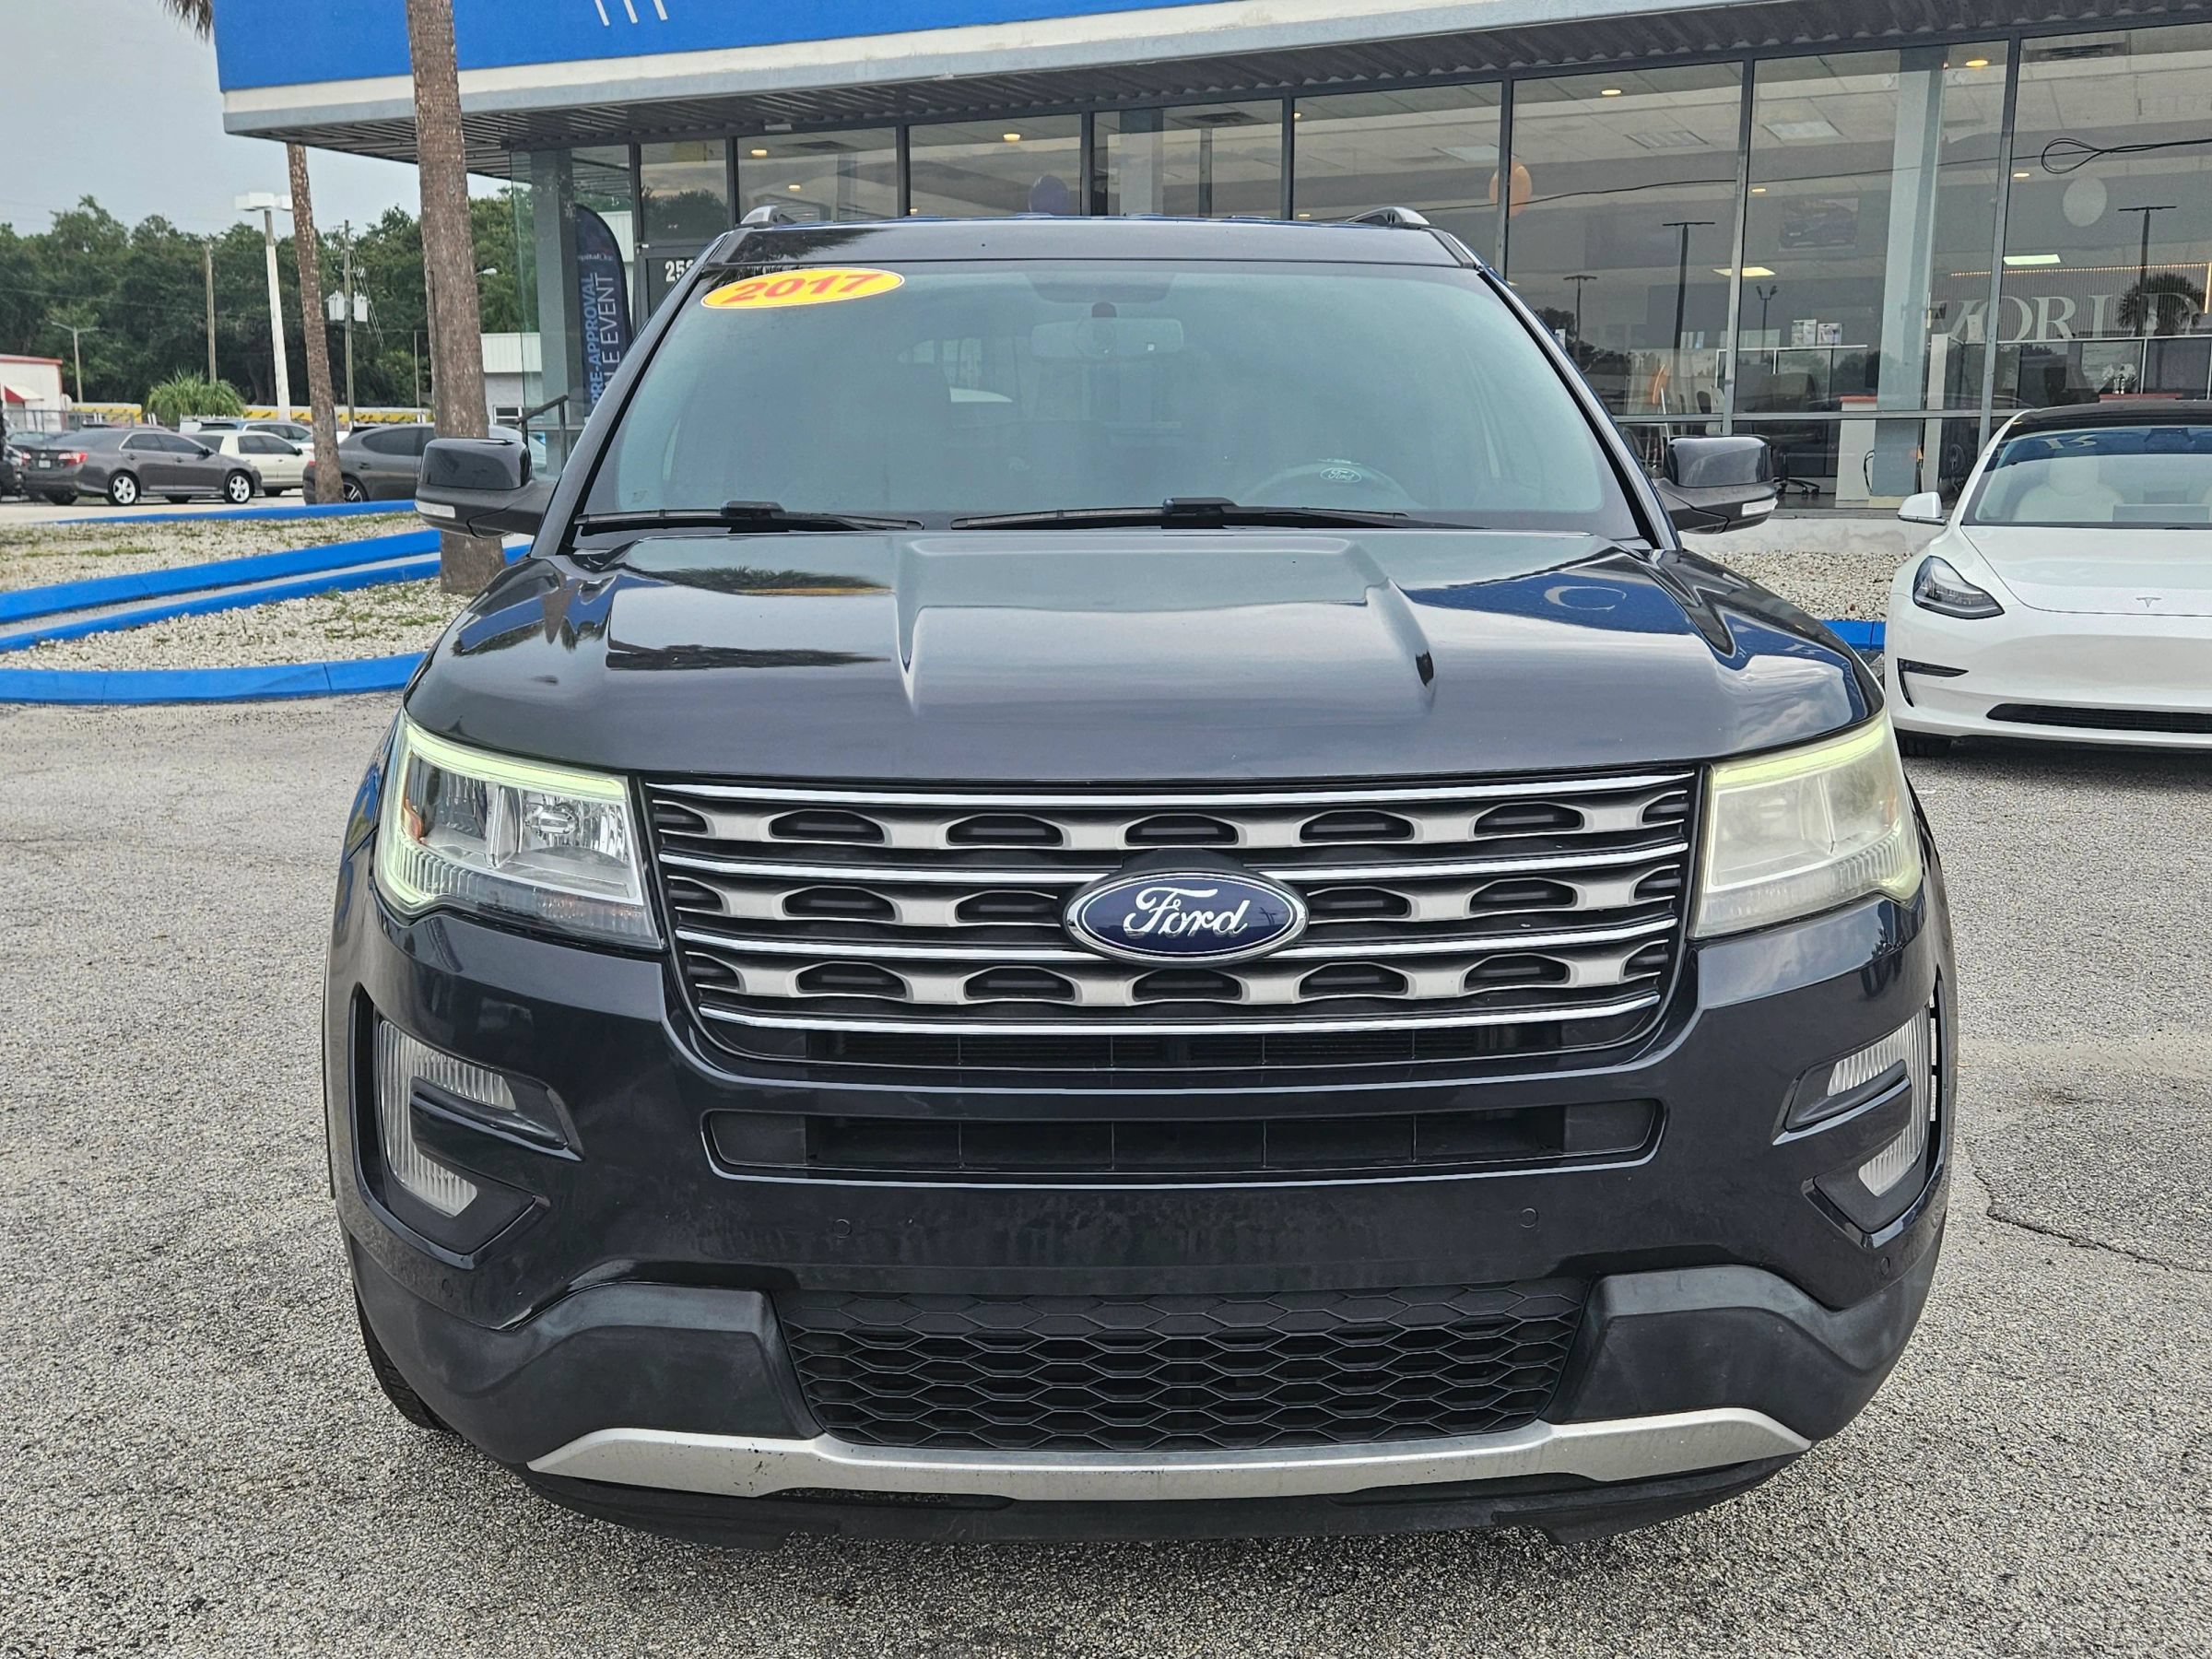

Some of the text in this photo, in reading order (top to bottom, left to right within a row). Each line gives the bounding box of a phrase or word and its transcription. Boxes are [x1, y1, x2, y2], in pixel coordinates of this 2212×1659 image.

[594, 272, 618, 344] EVENT
[720, 274, 887, 305] 2017
[581, 273, 603, 405] PRE-APPROVAL
[1124, 887, 1251, 938] Ford
